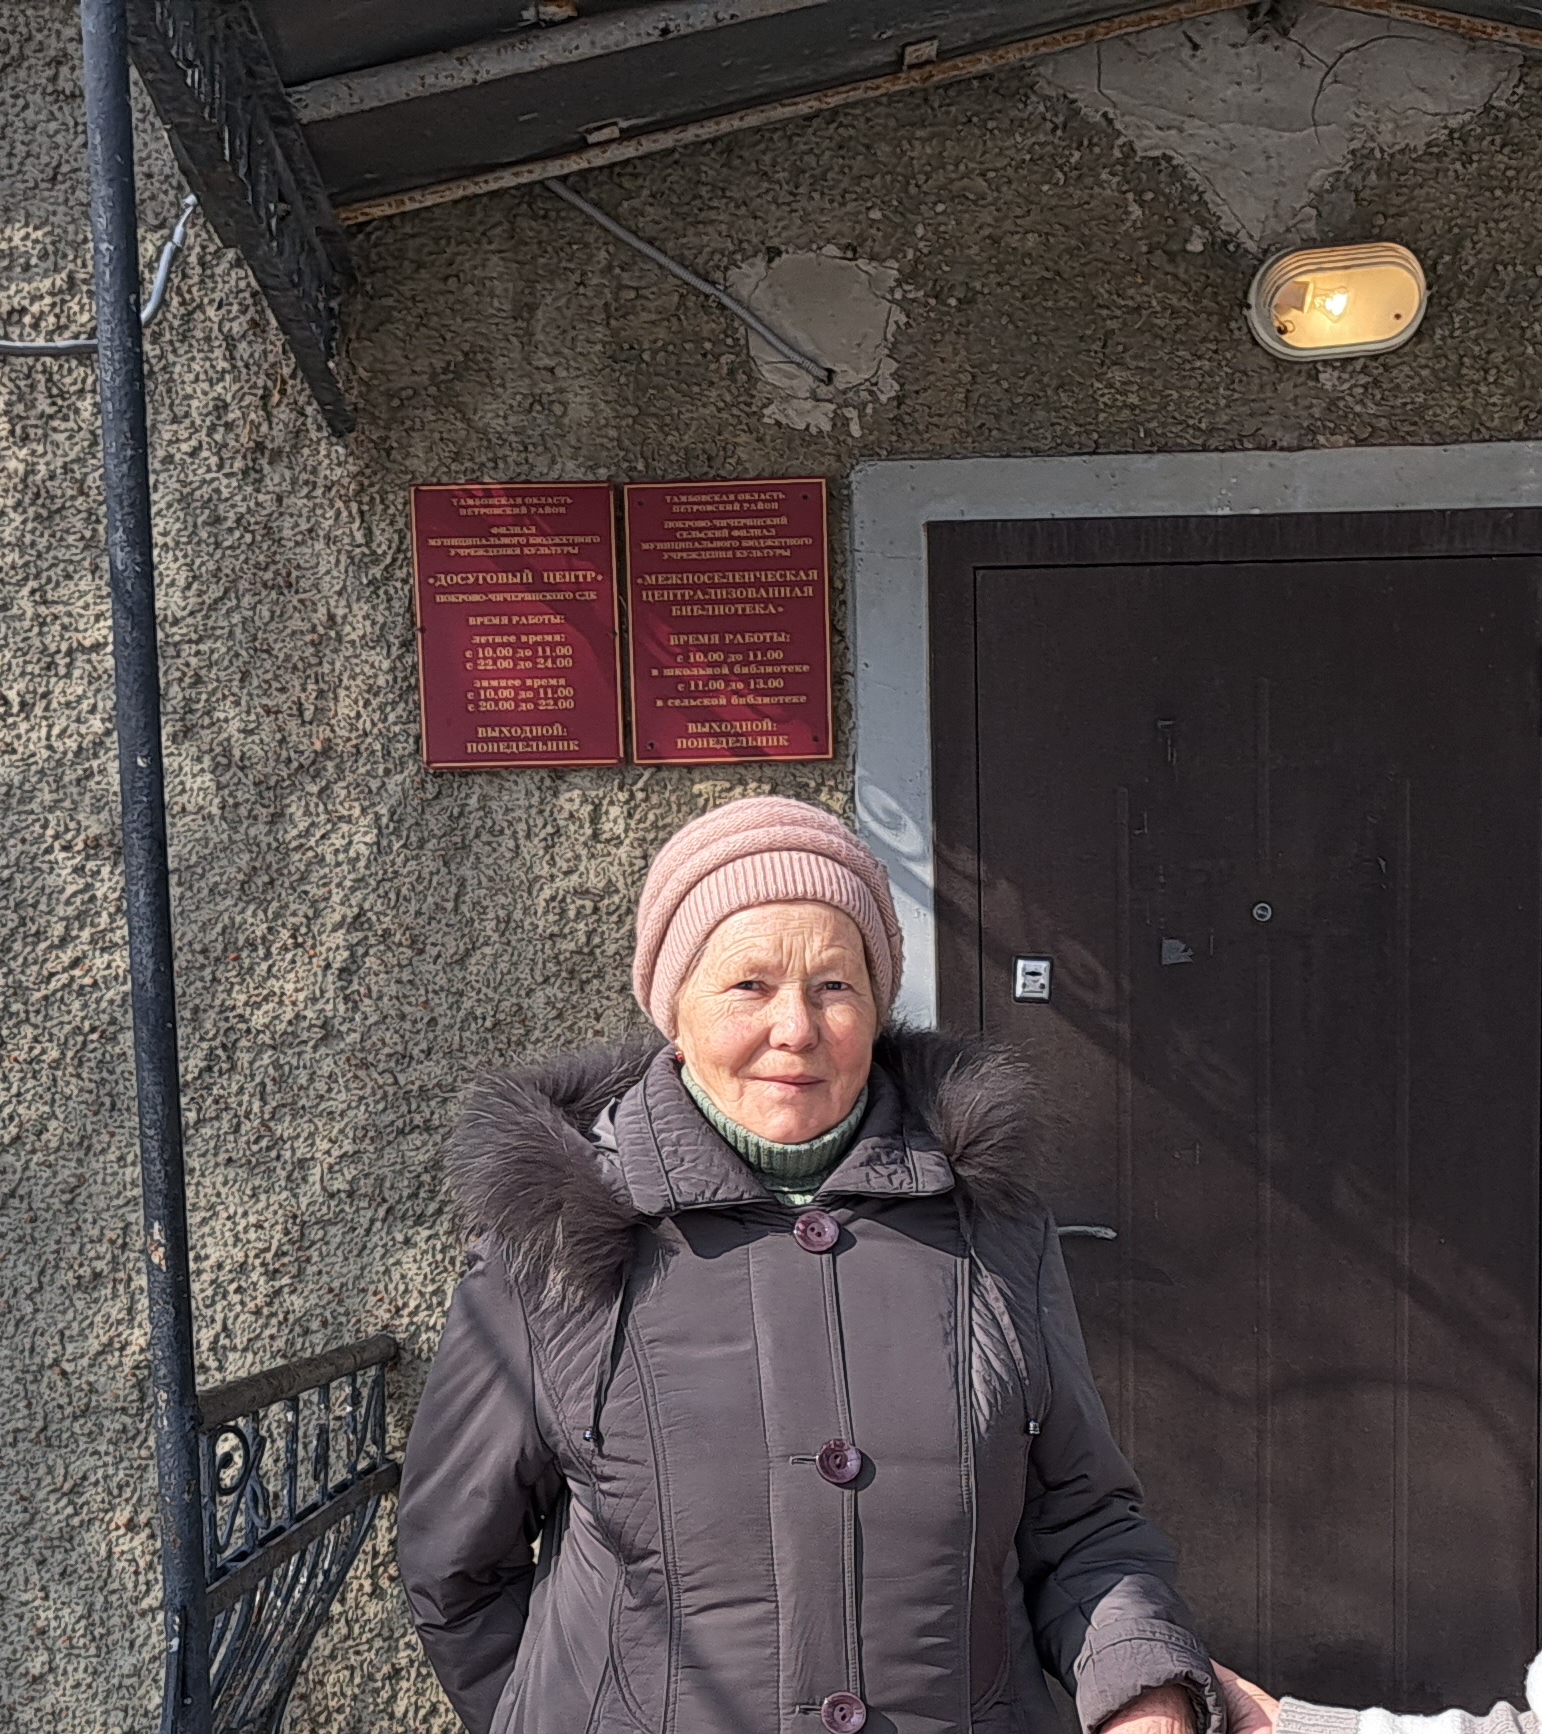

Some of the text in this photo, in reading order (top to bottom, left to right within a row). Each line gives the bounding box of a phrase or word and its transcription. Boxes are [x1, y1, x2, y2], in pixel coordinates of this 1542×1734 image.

[641, 586, 814, 603] ЦЕНТРАЛИЗОВАННАЯ
[468, 614, 565, 626] ВРЕМЯ РАБОТЫ:
[471, 634, 516, 644] летнее
[669, 632, 791, 646] ВРЕМЯ РАБОТЫ:
[464, 645, 573, 658] с 10.00 до 11.00
[676, 650, 784, 663] с 10.00 до 11.00
[465, 657, 573, 671] с 22.00 до 24.00
[662, 664, 730, 676] школьной
[733, 664, 810, 675] библиотеке
[525, 677, 566, 689] время
[677, 678, 784, 692] с 11.00 до 13.00
[466, 687, 574, 700] с 10.00 до 11.00
[467, 699, 575, 712] с 20.00 до 22.00
[667, 695, 727, 707] сельской
[730, 694, 807, 705] библиотеке
[477, 723, 568, 738] ВЫХОДНОЙ:
[687, 718, 777, 733] ВЫХОДНОЙ:
[466, 740, 580, 754] ПОНЕДЕЛЬНИК
[676, 735, 790, 749] ПОНЕДЕЛЬНИК
